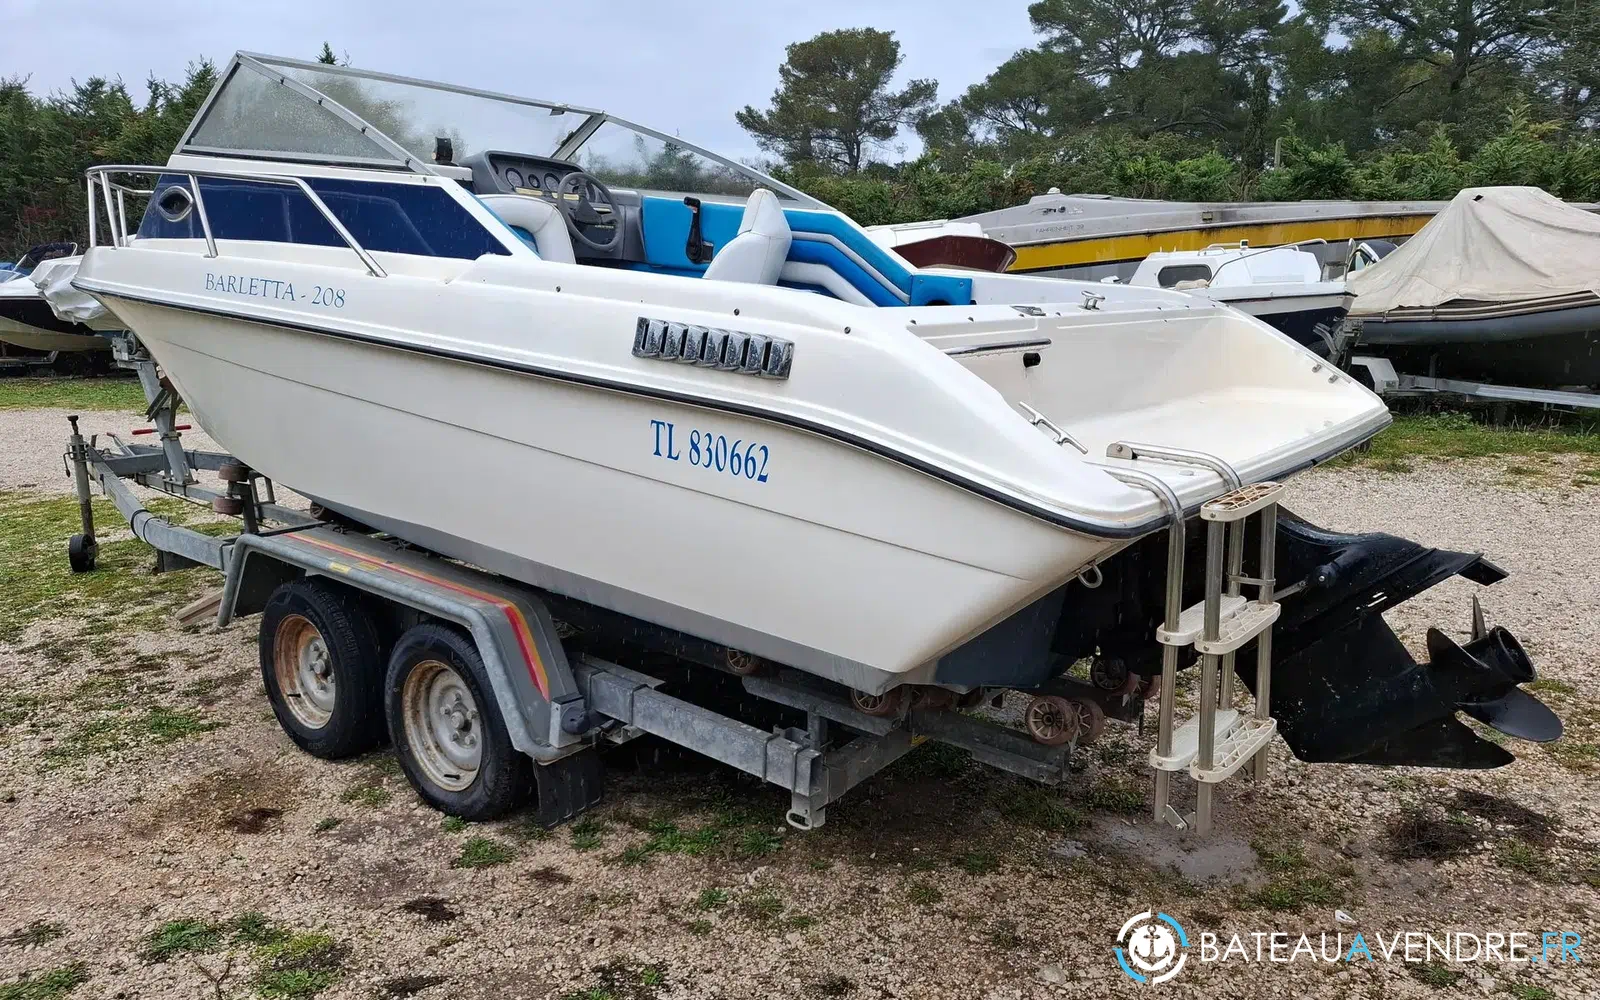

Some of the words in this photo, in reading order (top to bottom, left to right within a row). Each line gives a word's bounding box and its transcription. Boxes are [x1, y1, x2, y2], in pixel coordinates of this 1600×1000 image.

[205, 273, 296, 301] BARLETTA
[311, 285, 346, 308] 208
[650, 419, 681, 461] TL
[689, 429, 769, 483] 830662
